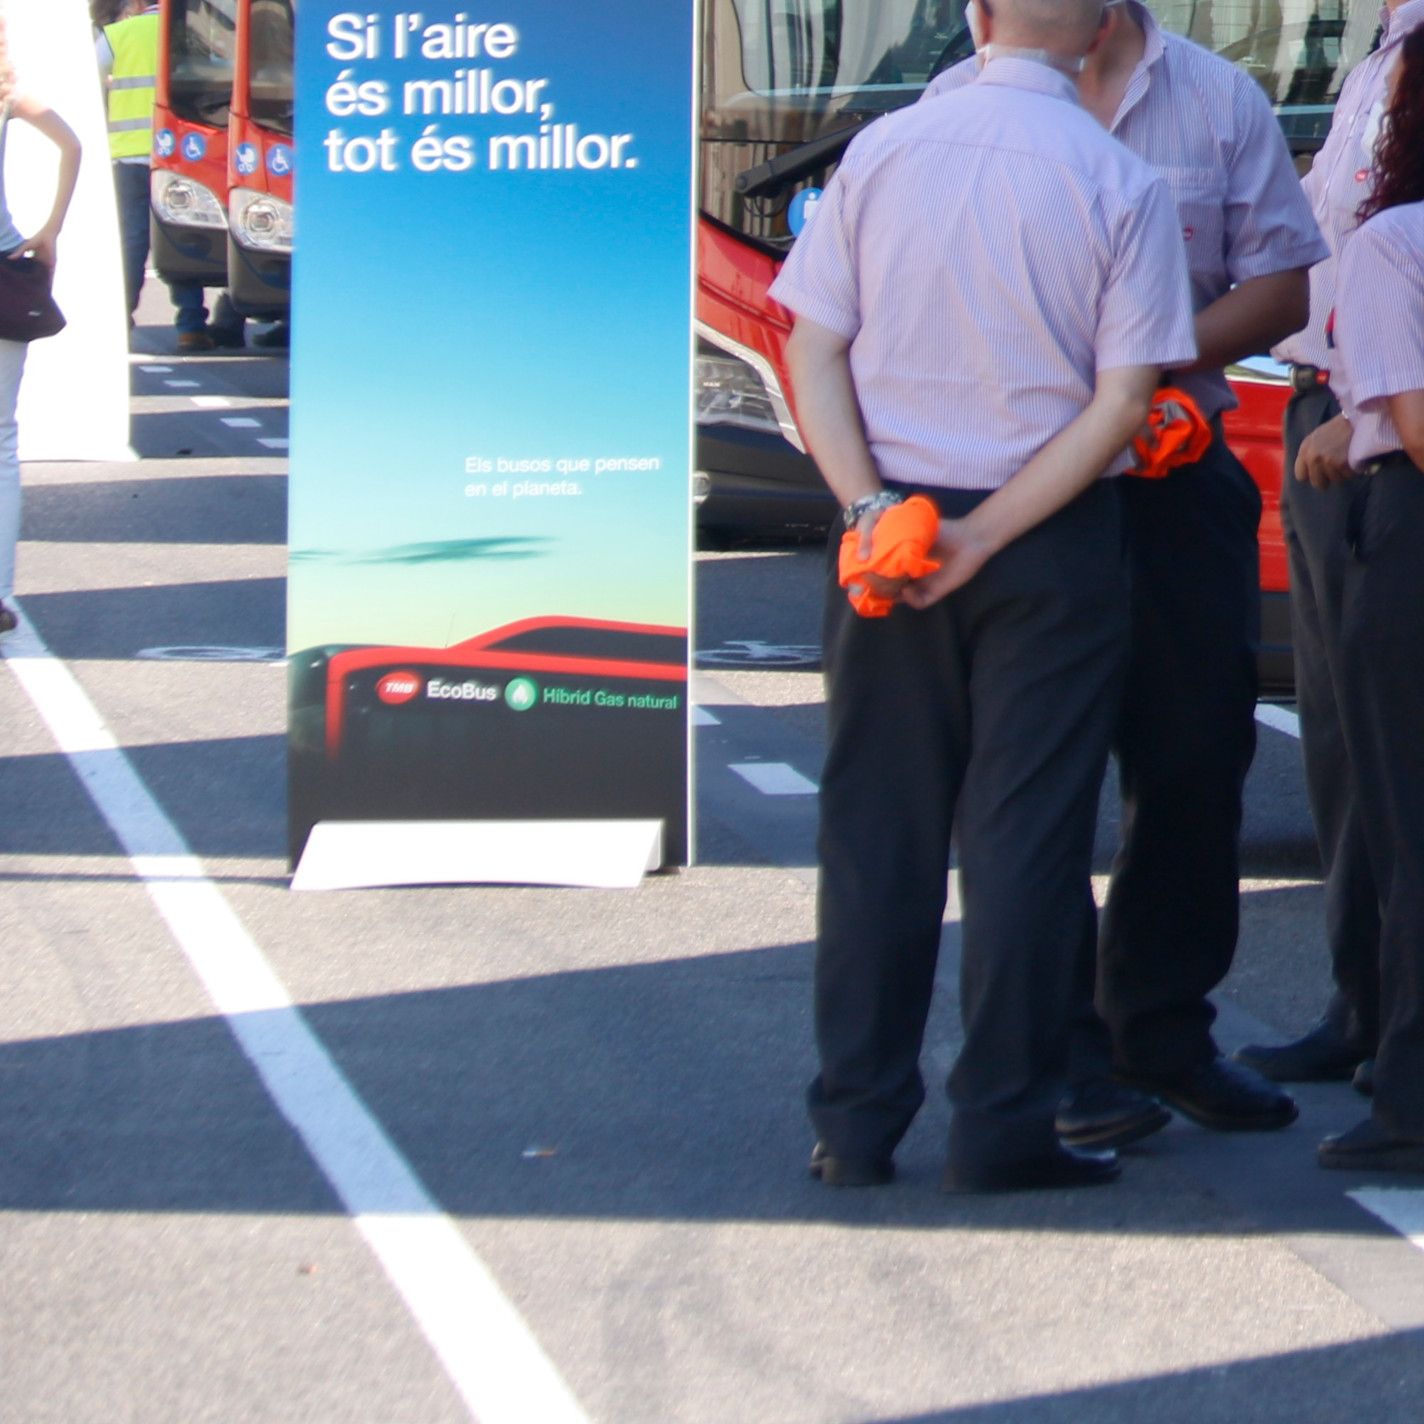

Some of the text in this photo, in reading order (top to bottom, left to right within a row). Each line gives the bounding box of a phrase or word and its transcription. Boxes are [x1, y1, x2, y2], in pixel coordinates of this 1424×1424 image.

[326, 13, 379, 61] Si
[325, 69, 553, 121] és millor,
[323, 124, 639, 173] tot és millor.
[464, 456, 660, 475] Els busos que pensen
[464, 480, 583, 499] en el planeta.
[384, 680, 416, 694] TMB
[427, 680, 497, 702] EcoBus
[594, 690, 624, 707] Gas
[627, 693, 677, 709] natural
